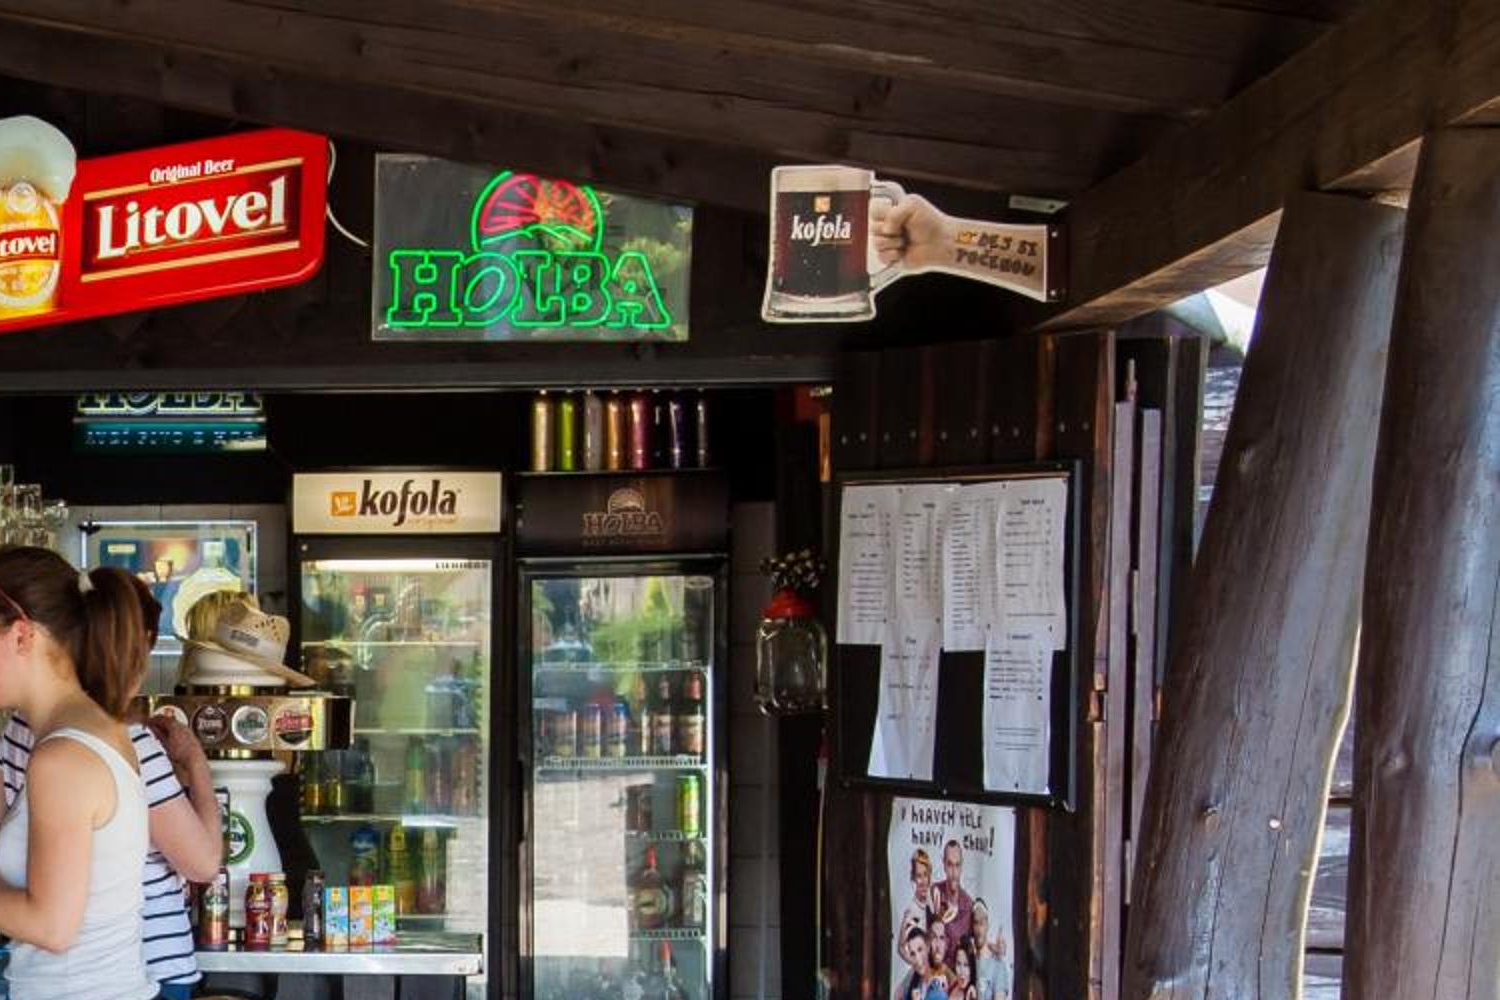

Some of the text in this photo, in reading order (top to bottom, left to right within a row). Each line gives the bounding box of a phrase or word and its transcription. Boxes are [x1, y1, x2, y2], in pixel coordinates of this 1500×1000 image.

[149, 158, 235, 183] Original Beer
[96, 174, 288, 260] Litovel
[789, 213, 853, 243] kofola
[386, 249, 671, 328] HOLBA
[358, 478, 457, 527] kofola
